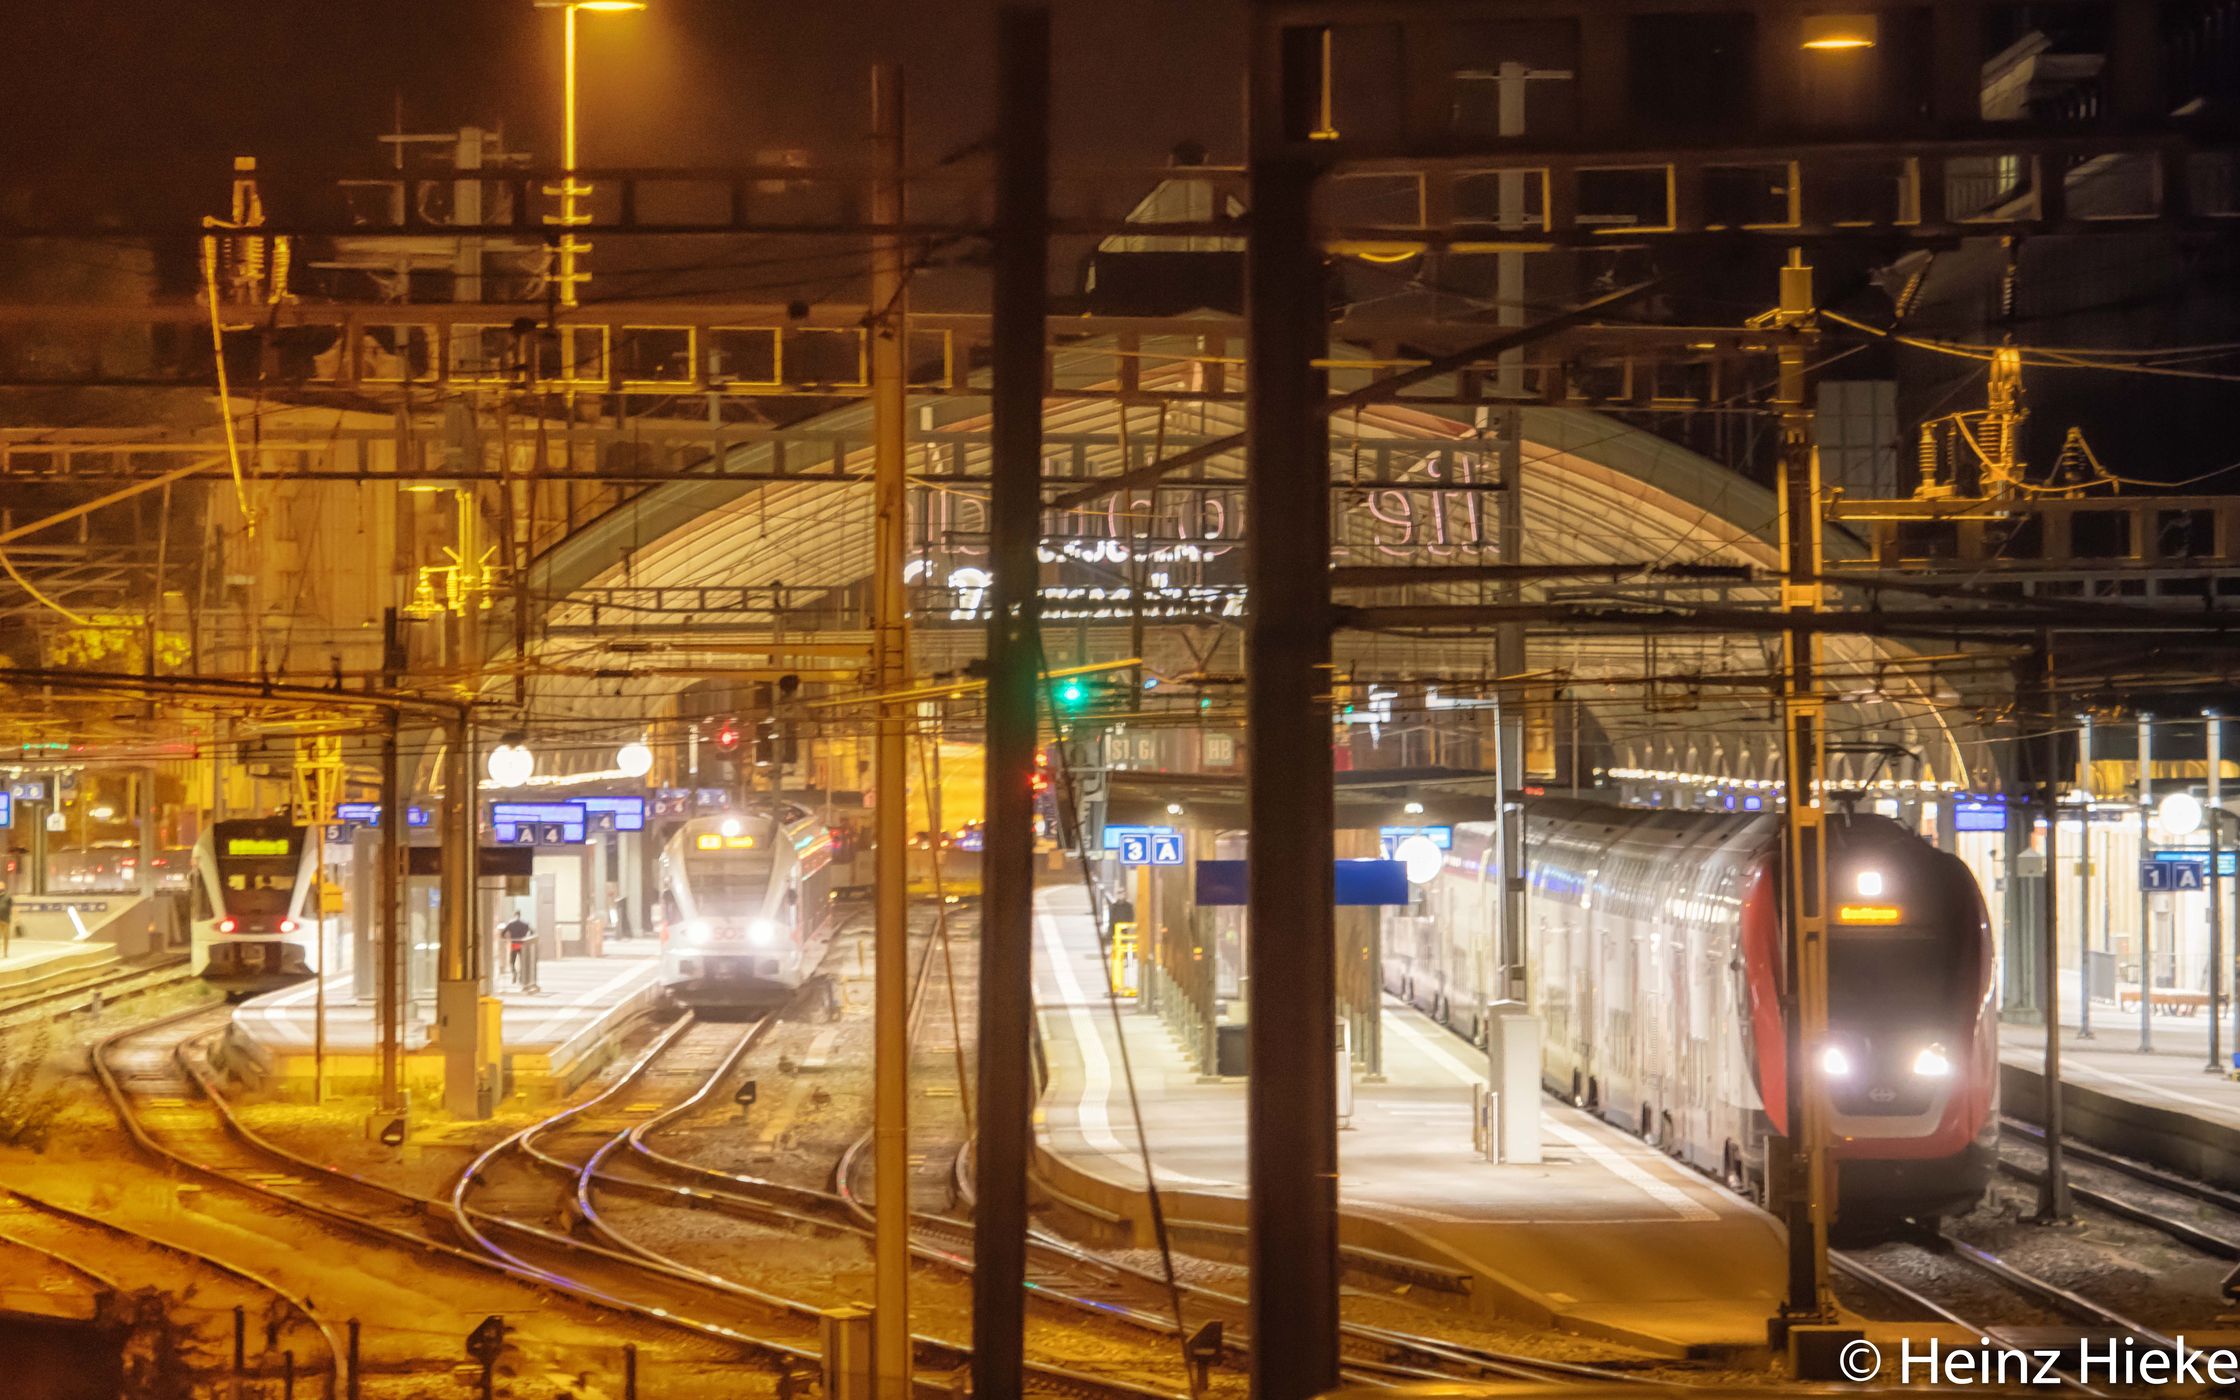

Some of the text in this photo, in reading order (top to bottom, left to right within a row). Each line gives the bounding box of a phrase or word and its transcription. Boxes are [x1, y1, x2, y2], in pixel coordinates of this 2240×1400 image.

[327, 825, 340, 840] 5
[519, 827, 558, 843] A 4
[1127, 841, 1177, 861] 3 A
[2149, 869, 2197, 888] 1 A
